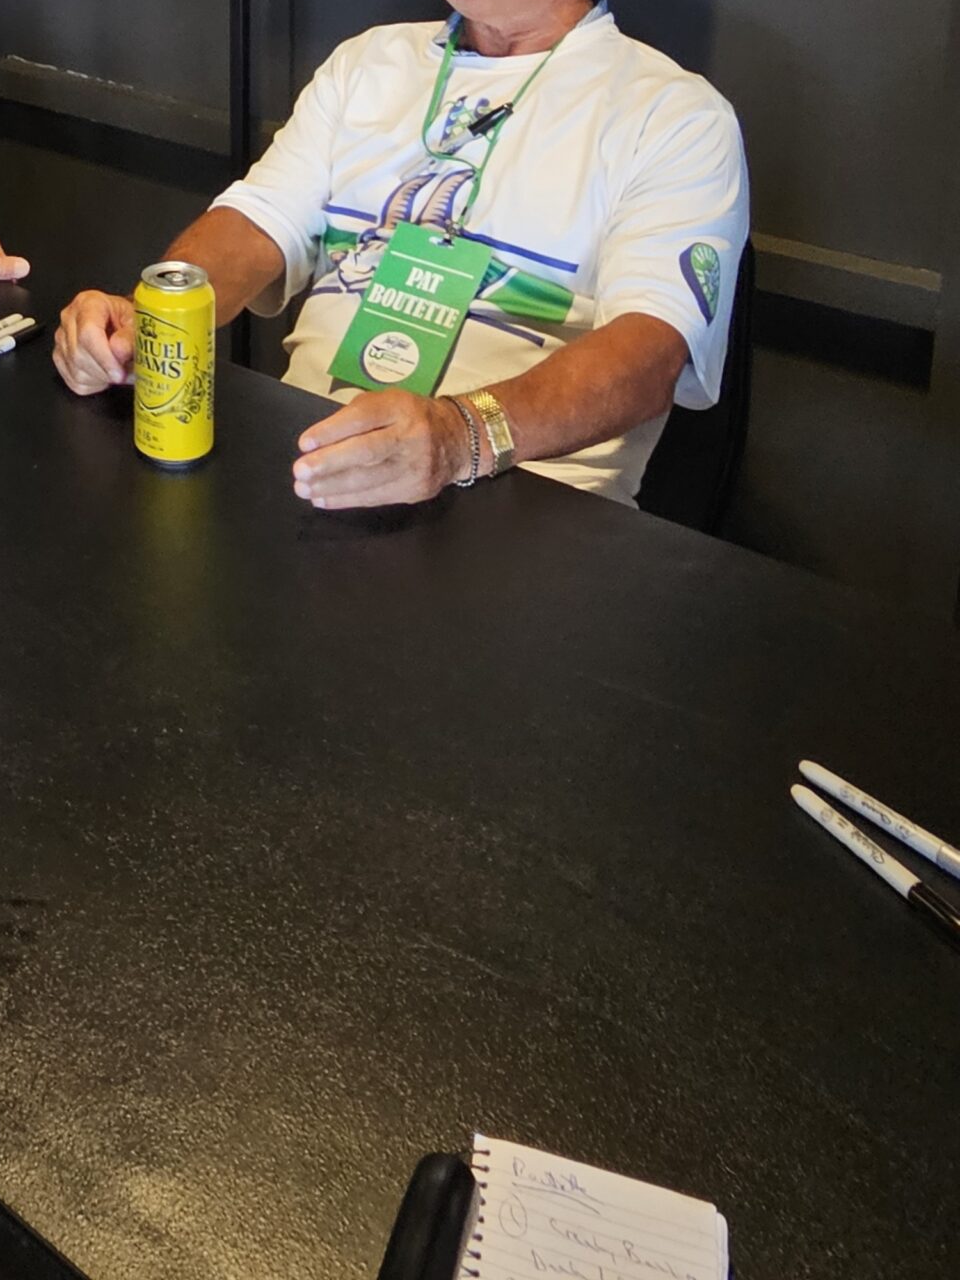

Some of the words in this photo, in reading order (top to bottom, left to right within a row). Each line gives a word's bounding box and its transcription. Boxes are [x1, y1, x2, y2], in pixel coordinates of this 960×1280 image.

[405, 266, 445, 295] PAT
[367, 282, 460, 329] BOUTETTE
[136, 334, 189, 361] MUEL
